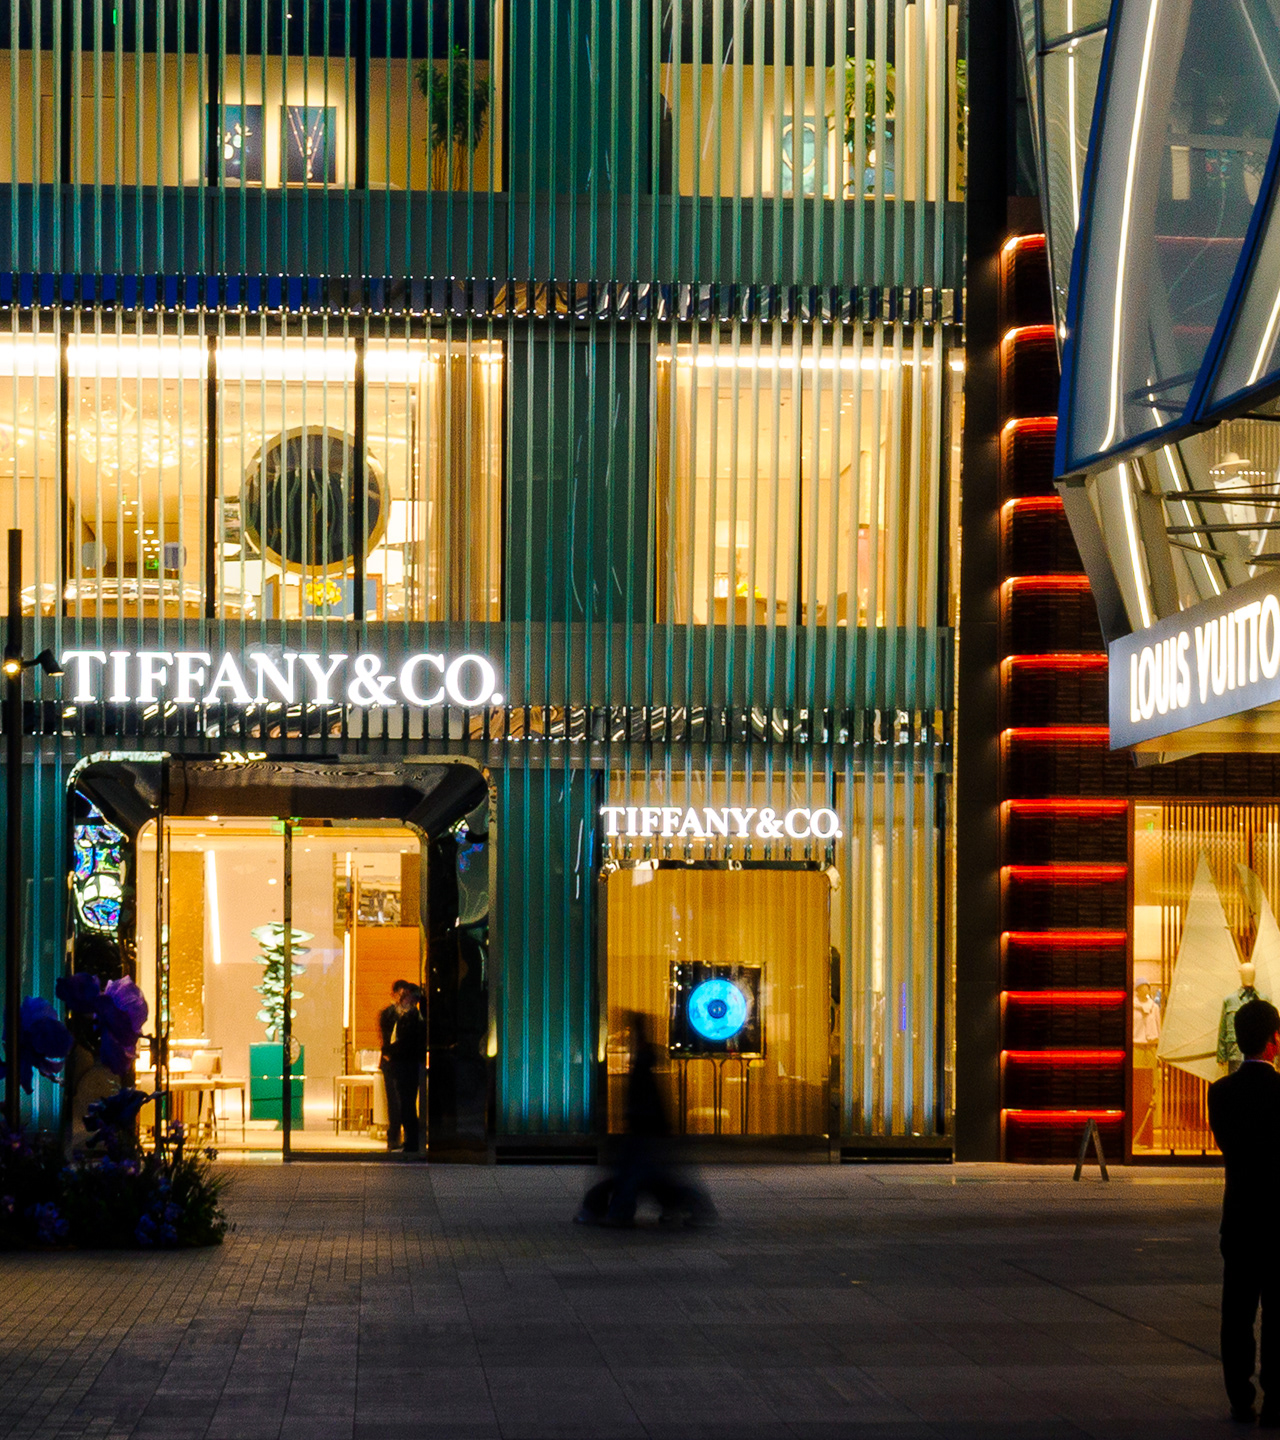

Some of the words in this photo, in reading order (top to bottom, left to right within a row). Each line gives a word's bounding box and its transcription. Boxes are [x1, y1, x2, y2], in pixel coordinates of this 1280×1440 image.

[61, 650, 504, 706] TIFFANY&CO.
[1130, 632, 1191, 723] LOUIS
[599, 806, 843, 839] TIFFANY&CO.
